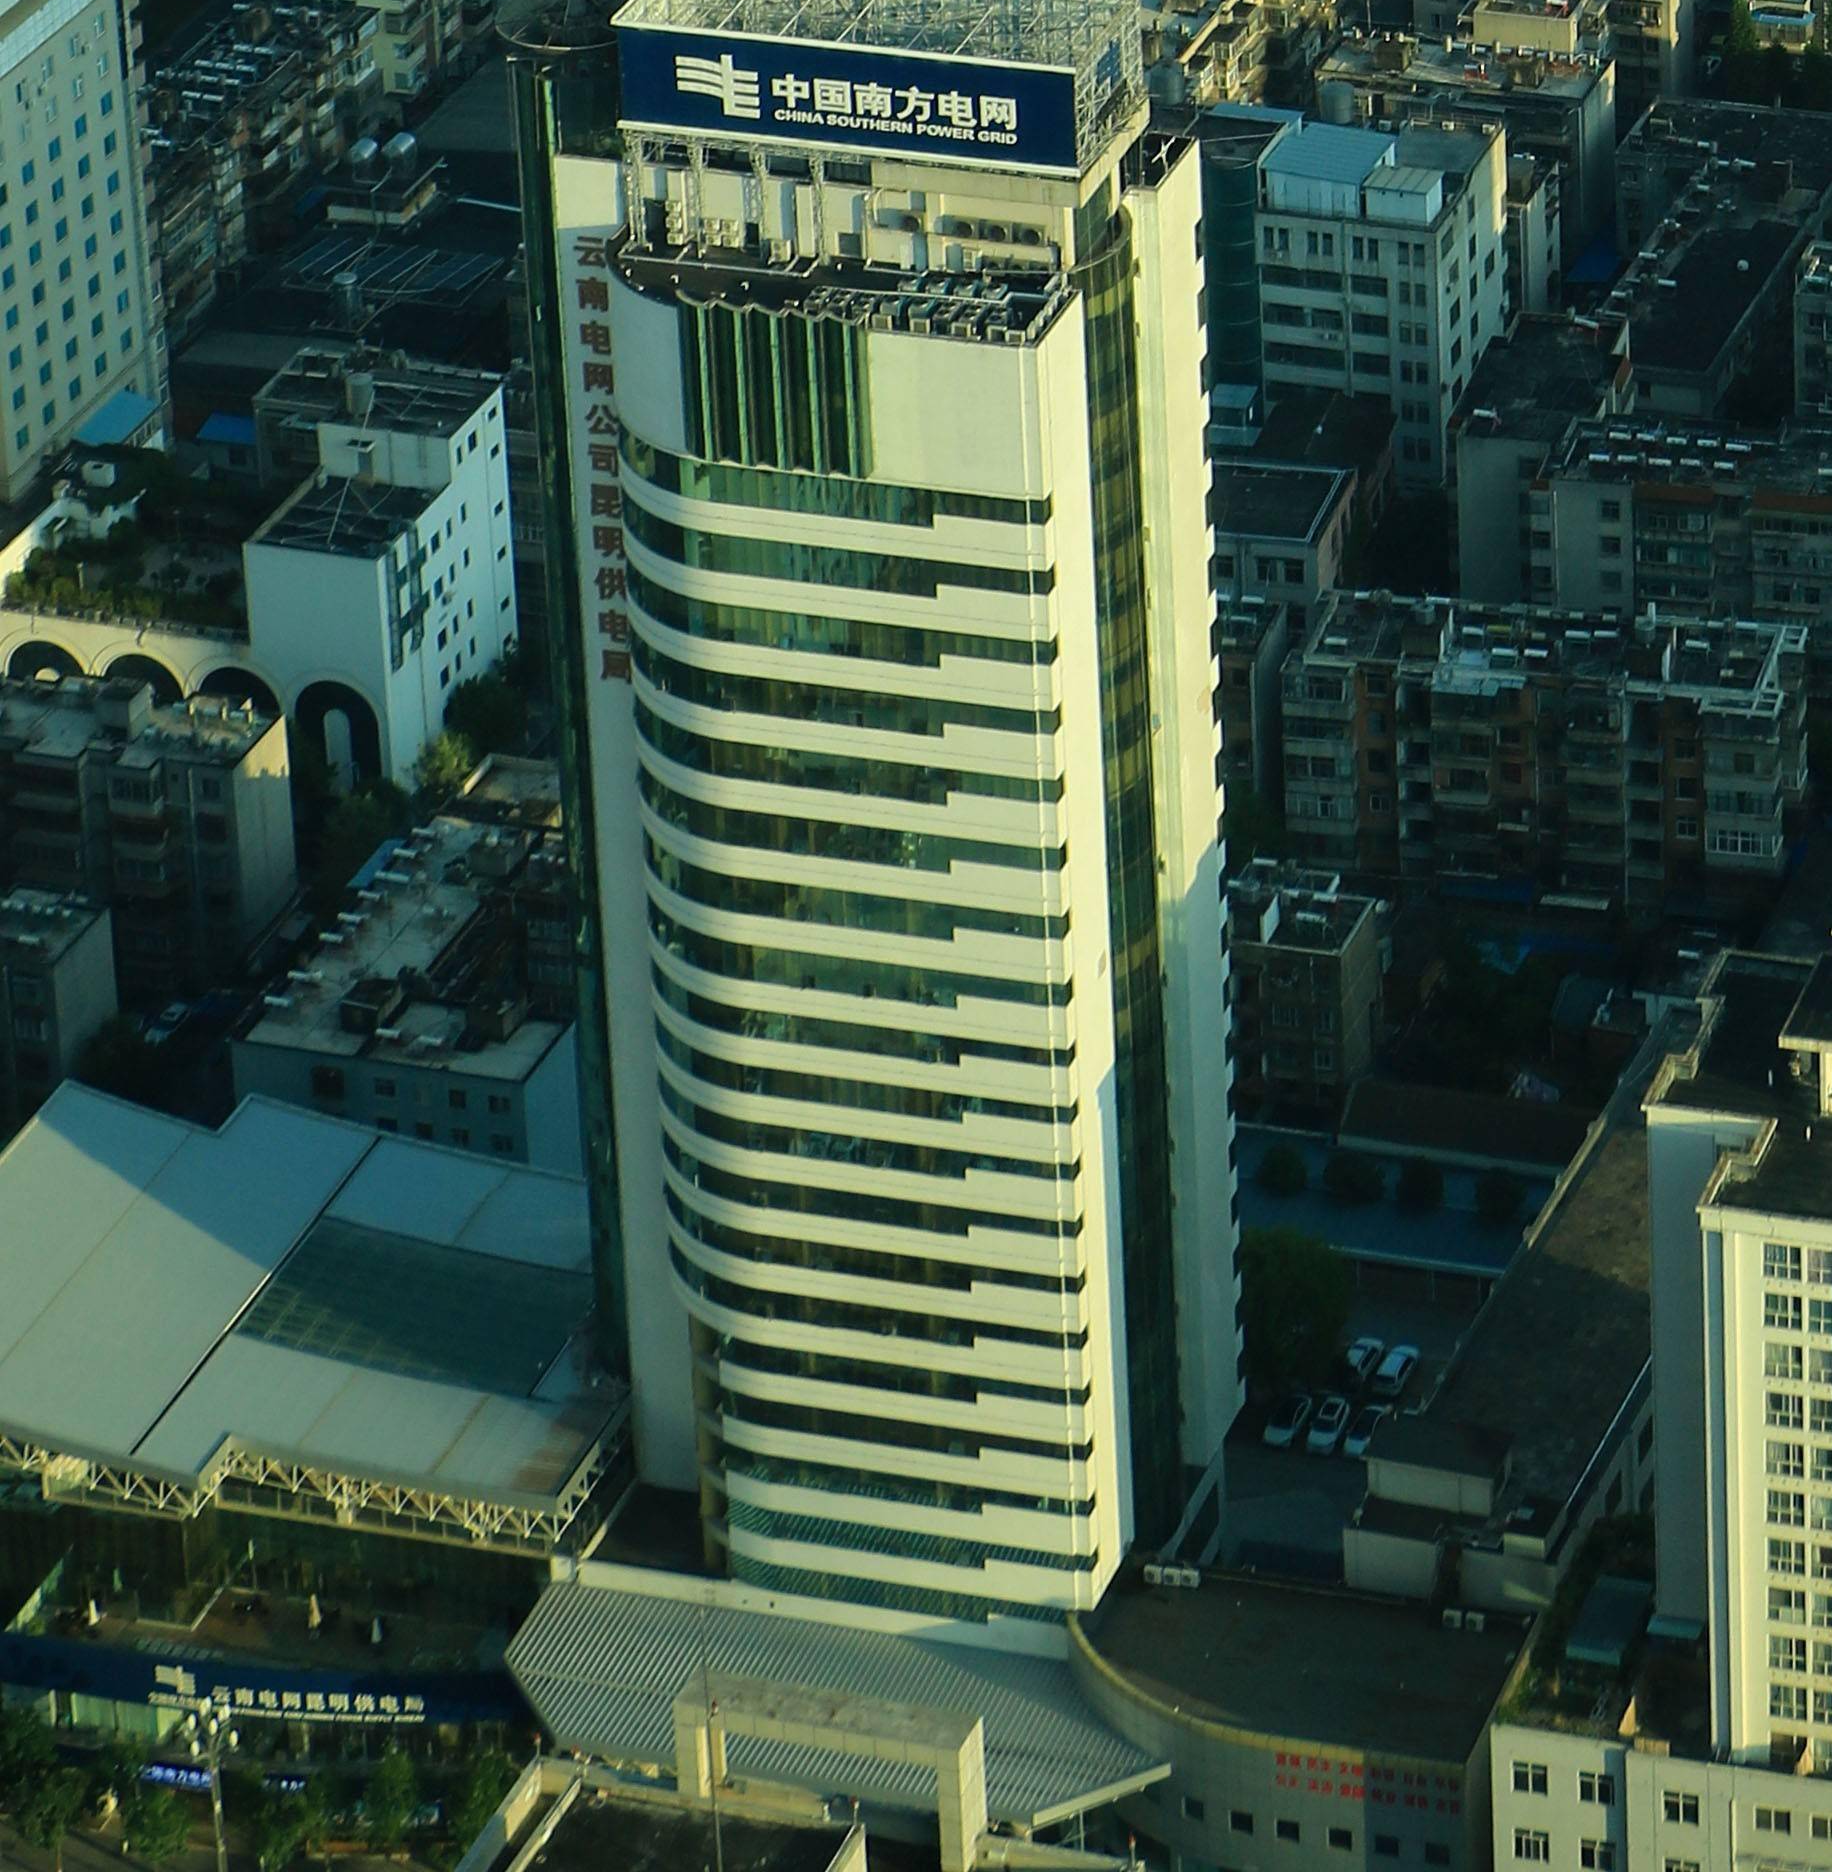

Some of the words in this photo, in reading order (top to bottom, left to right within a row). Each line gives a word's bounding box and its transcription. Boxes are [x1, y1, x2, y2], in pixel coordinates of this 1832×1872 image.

[771, 73, 1018, 131] 中国南方电网
[774, 109, 824, 125] CHINA
[826, 113, 913, 134] SOUTHERN
[916, 123, 975, 141] POWER
[977, 129, 1018, 145] GRID
[573, 233, 633, 684] 云南电网公司昆明供电局
[212, 1685, 425, 1714] 云南电网昆明供电局
